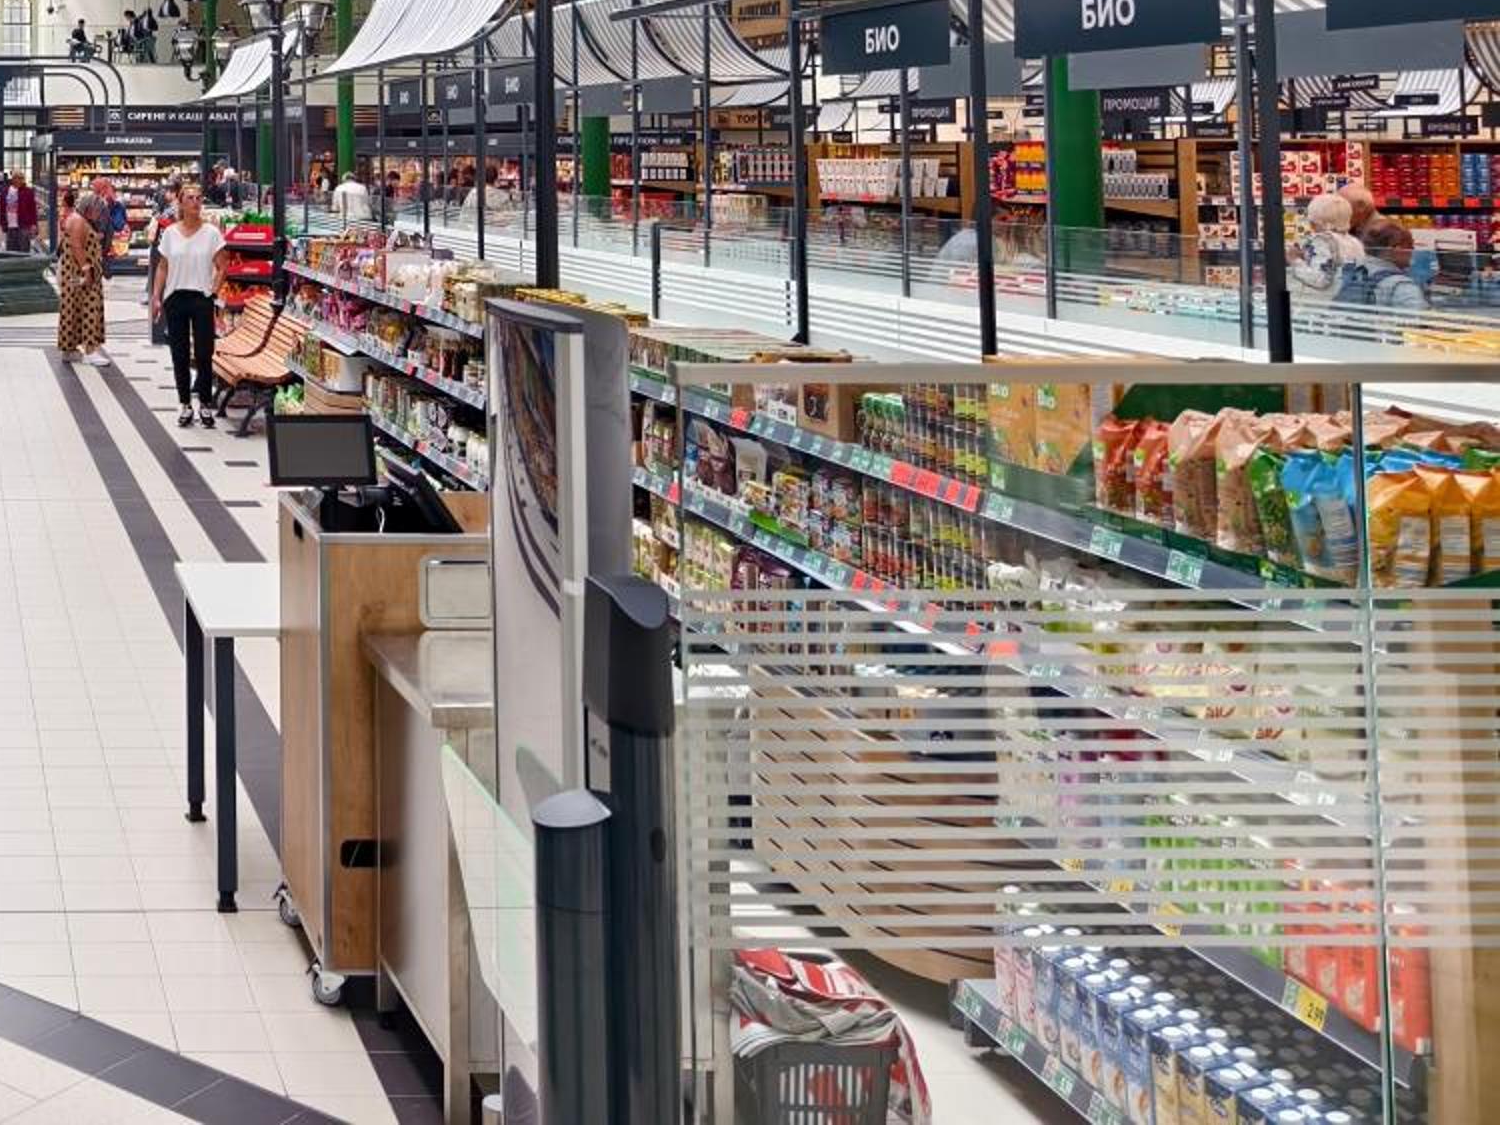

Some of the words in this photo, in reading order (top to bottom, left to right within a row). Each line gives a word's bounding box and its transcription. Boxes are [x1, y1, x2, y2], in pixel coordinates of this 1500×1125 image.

[864, 24, 900, 54] БИО
[1102, 96, 1160, 112] ПРОМОЦИЯ
[179, 112, 238, 122] КАШАВАЛ
